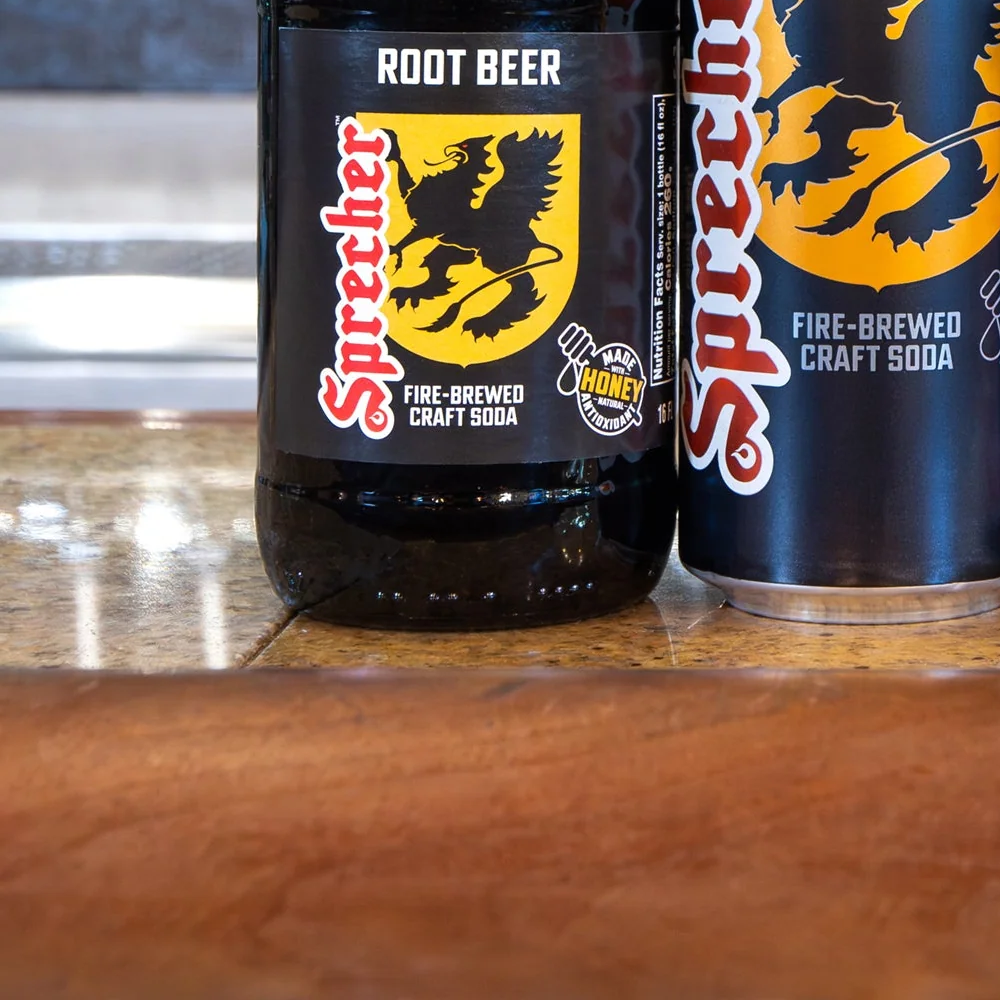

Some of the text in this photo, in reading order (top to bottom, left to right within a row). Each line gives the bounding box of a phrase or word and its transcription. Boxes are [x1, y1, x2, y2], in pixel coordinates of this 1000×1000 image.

[377, 48, 561, 86] ROOT BEER
[657, 133, 666, 152] (16
[657, 154, 665, 188] bottle
[656, 200, 665, 228] size:
[657, 229, 665, 259] Serv.
[664, 221, 672, 291] Calories
[318, 115, 404, 440] Sprecher
[654, 262, 665, 307] Facts
[793, 311, 961, 340] FIRE-BREWED
[602, 348, 636, 372] MADE
[653, 310, 665, 381] Nutrition
[801, 343, 954, 371] CRAFT SODA
[404, 384, 524, 405] FIRE-BREWED
[580, 367, 643, 403] HONEY
[409, 407, 518, 427] CRAFT SODA
[581, 393, 636, 430] ANTIOXIDANT
[658, 403, 666, 424] 16
